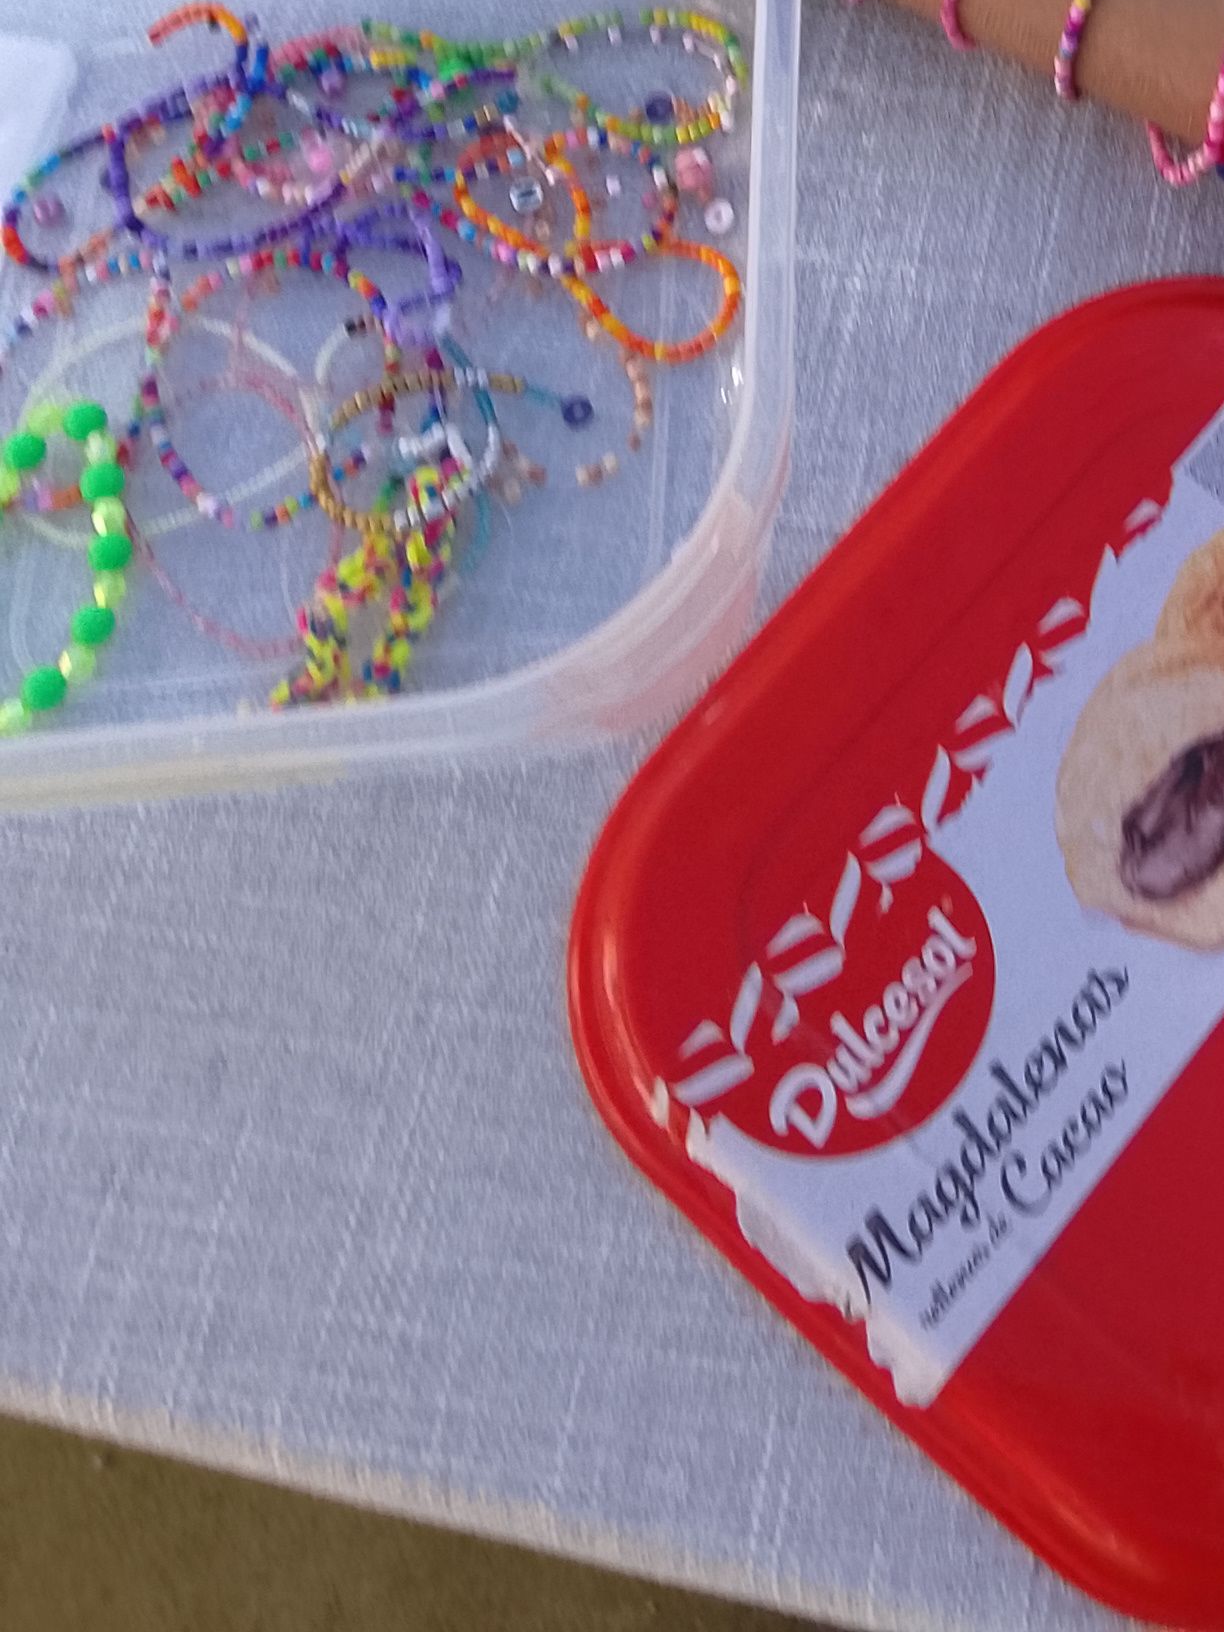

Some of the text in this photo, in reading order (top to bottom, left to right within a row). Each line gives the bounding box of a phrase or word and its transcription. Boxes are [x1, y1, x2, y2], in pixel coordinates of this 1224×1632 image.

[768, 905, 978, 1150] Dulcesol
[844, 965, 1131, 1306] Magdalenas
[999, 1056, 1130, 1220] Cacao
